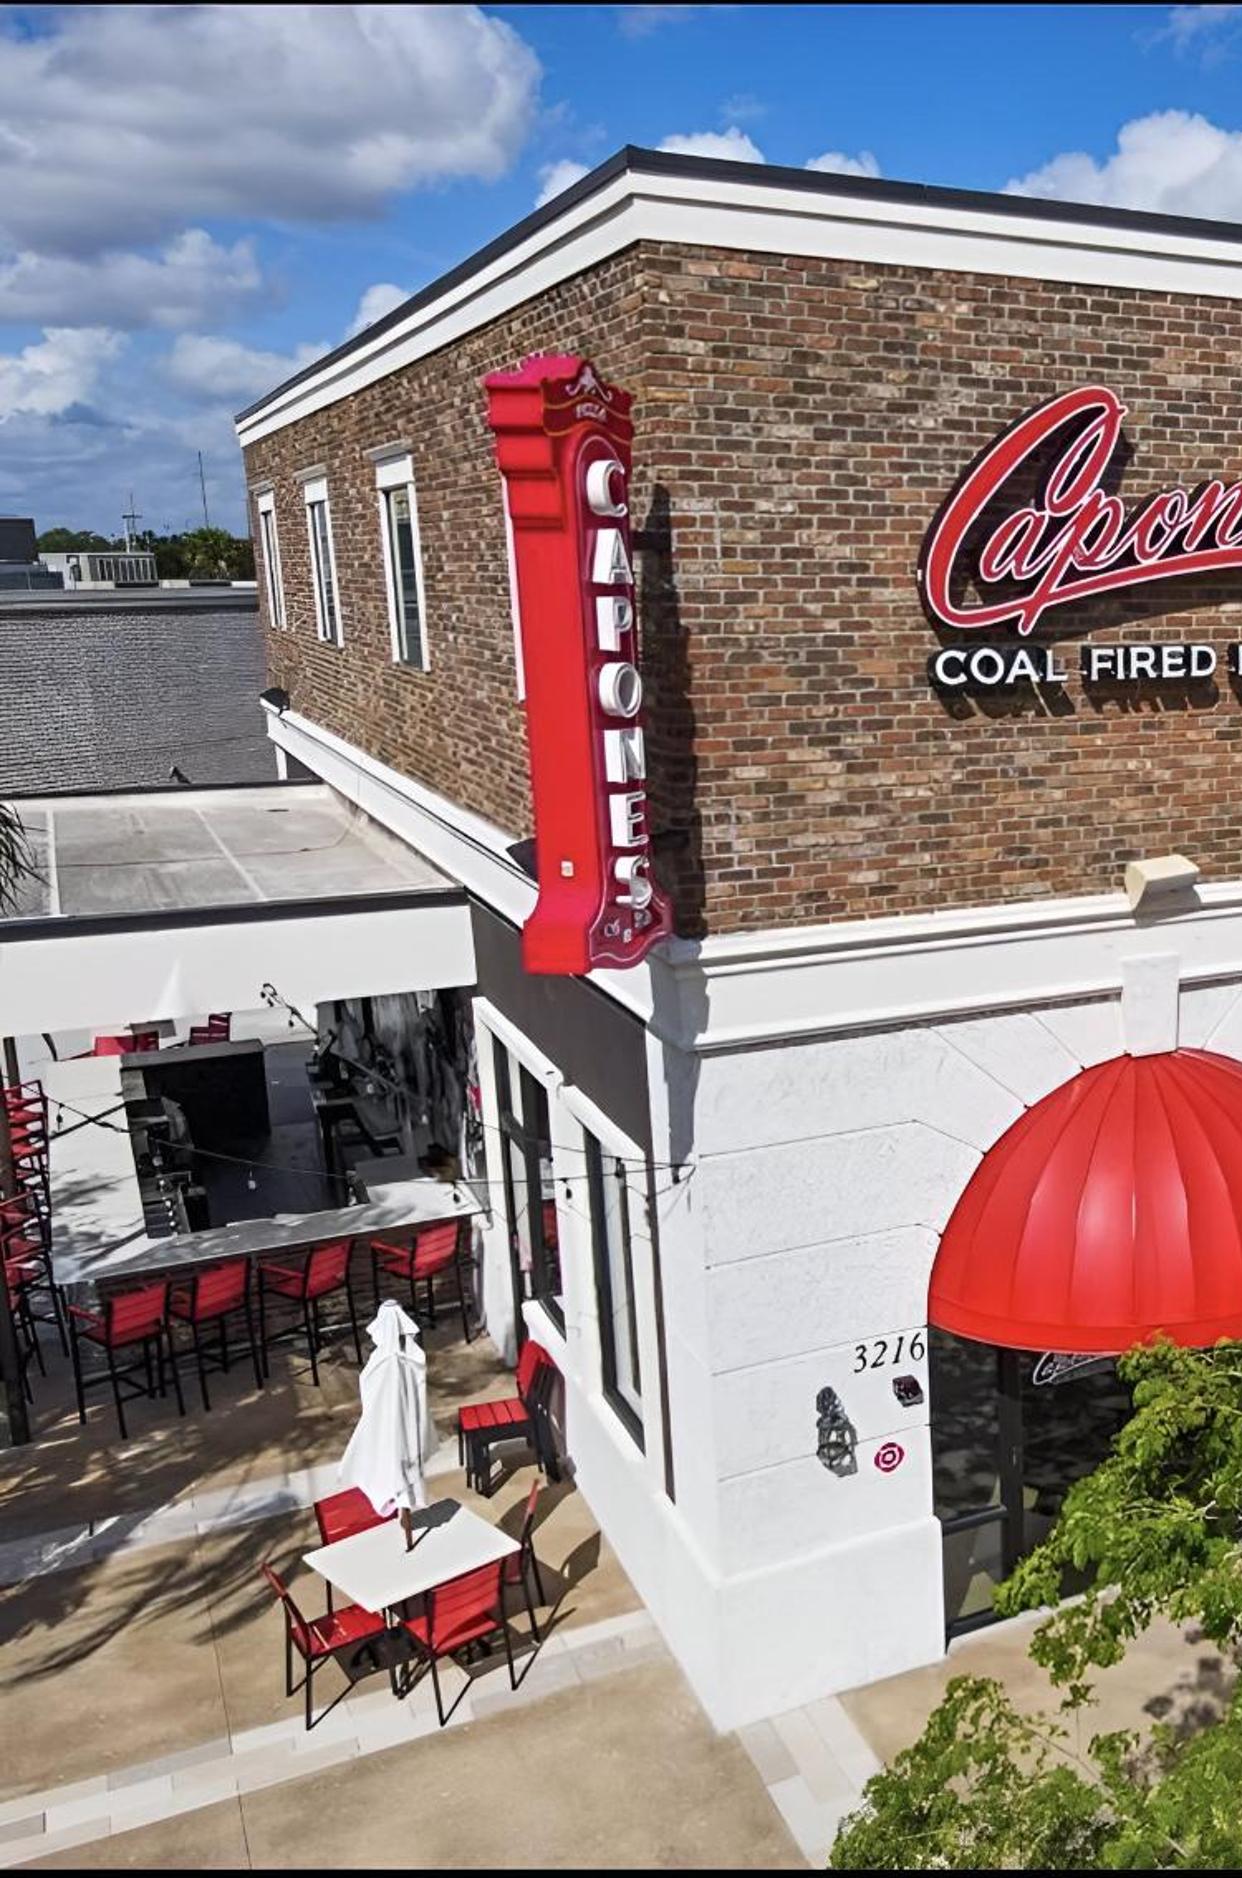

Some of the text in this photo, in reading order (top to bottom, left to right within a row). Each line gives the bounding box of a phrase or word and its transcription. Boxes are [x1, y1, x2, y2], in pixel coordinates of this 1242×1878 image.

[935, 648, 1068, 686] COAL
[1090, 645, 1217, 681] FIRED
[853, 1332, 925, 1373] 3216
